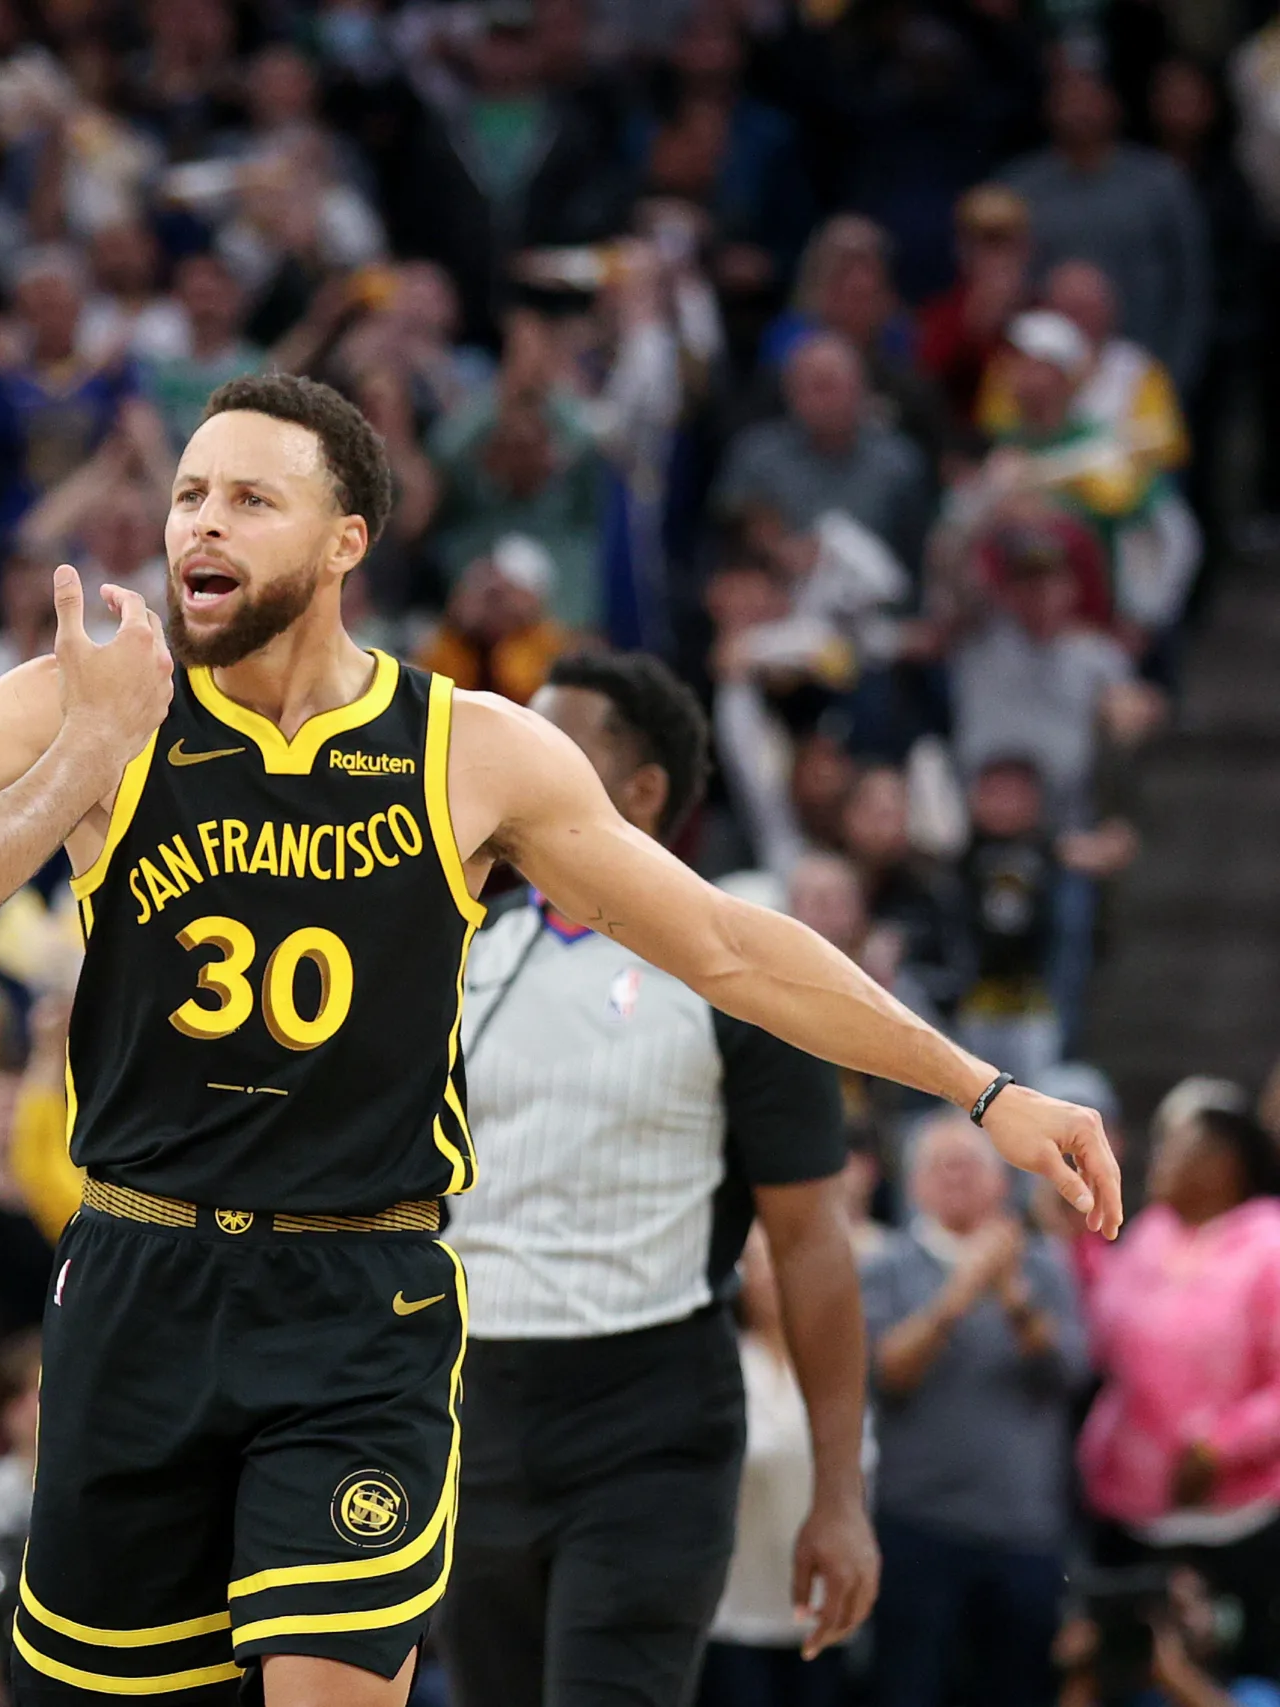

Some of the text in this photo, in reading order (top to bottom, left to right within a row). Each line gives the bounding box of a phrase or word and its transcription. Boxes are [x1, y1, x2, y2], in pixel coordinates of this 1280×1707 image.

[329, 749, 415, 776] Rakuten
[129, 804, 422, 924] SAN FRANCISCO
[168, 916, 354, 1051] 30
